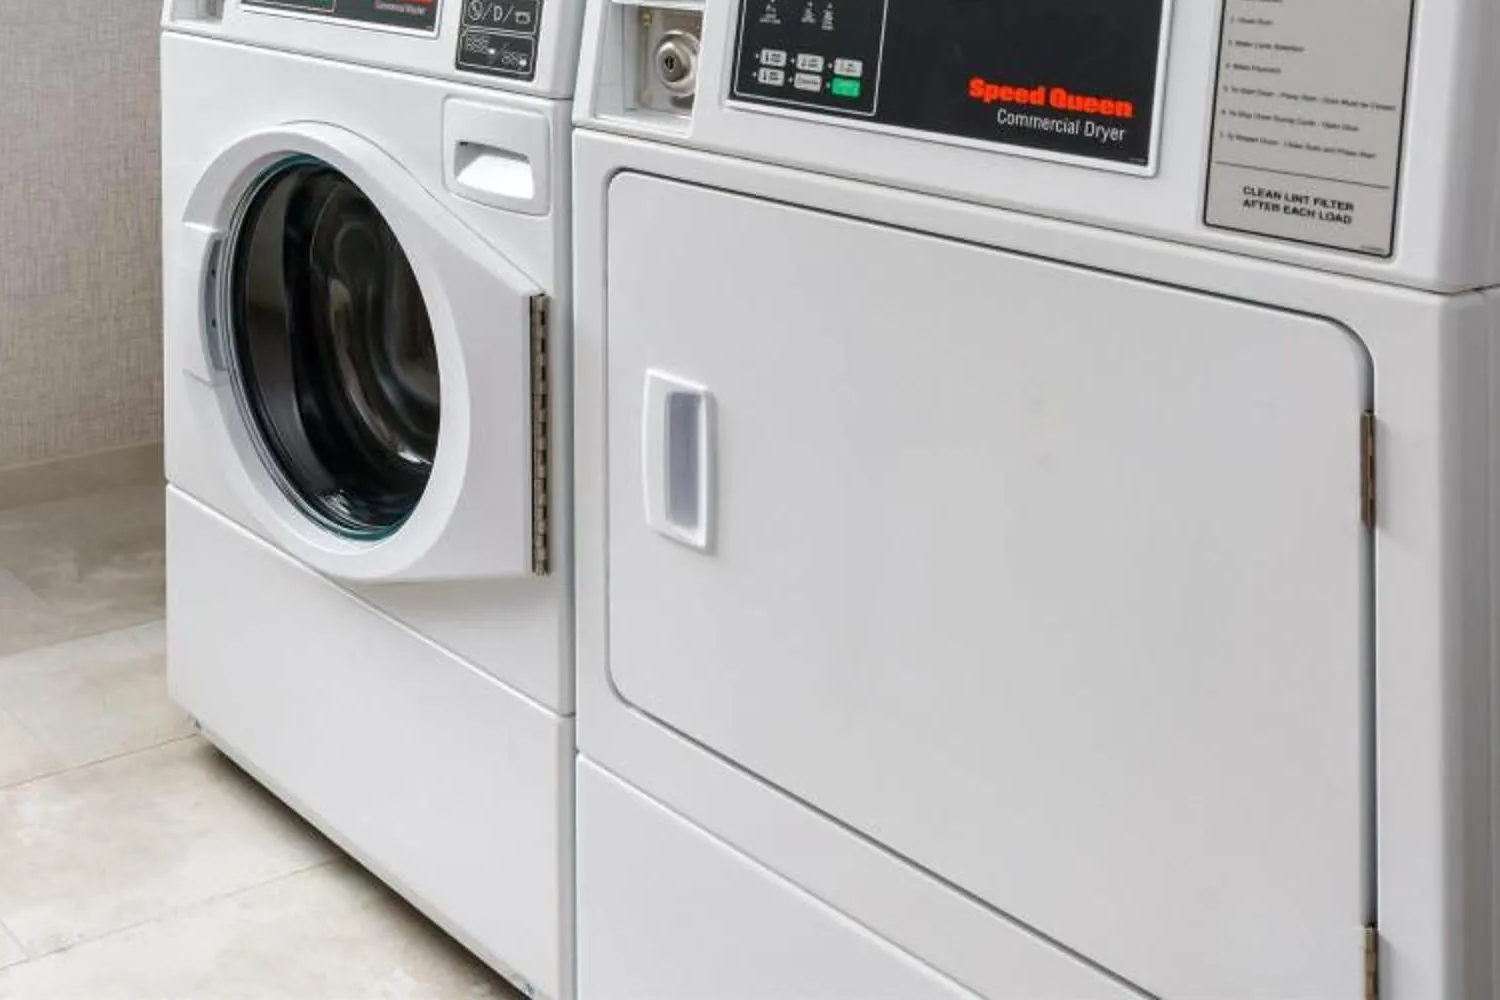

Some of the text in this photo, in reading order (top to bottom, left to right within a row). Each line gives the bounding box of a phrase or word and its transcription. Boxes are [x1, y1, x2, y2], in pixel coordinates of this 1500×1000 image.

[968, 77, 1134, 118] Speed Queen
[997, 107, 1126, 143] Commercial Dryer
[1242, 185, 1282, 201] CLEAN
[1313, 196, 1355, 212] FILTER
[1242, 199, 1353, 225] AFTER EACH LOAD
